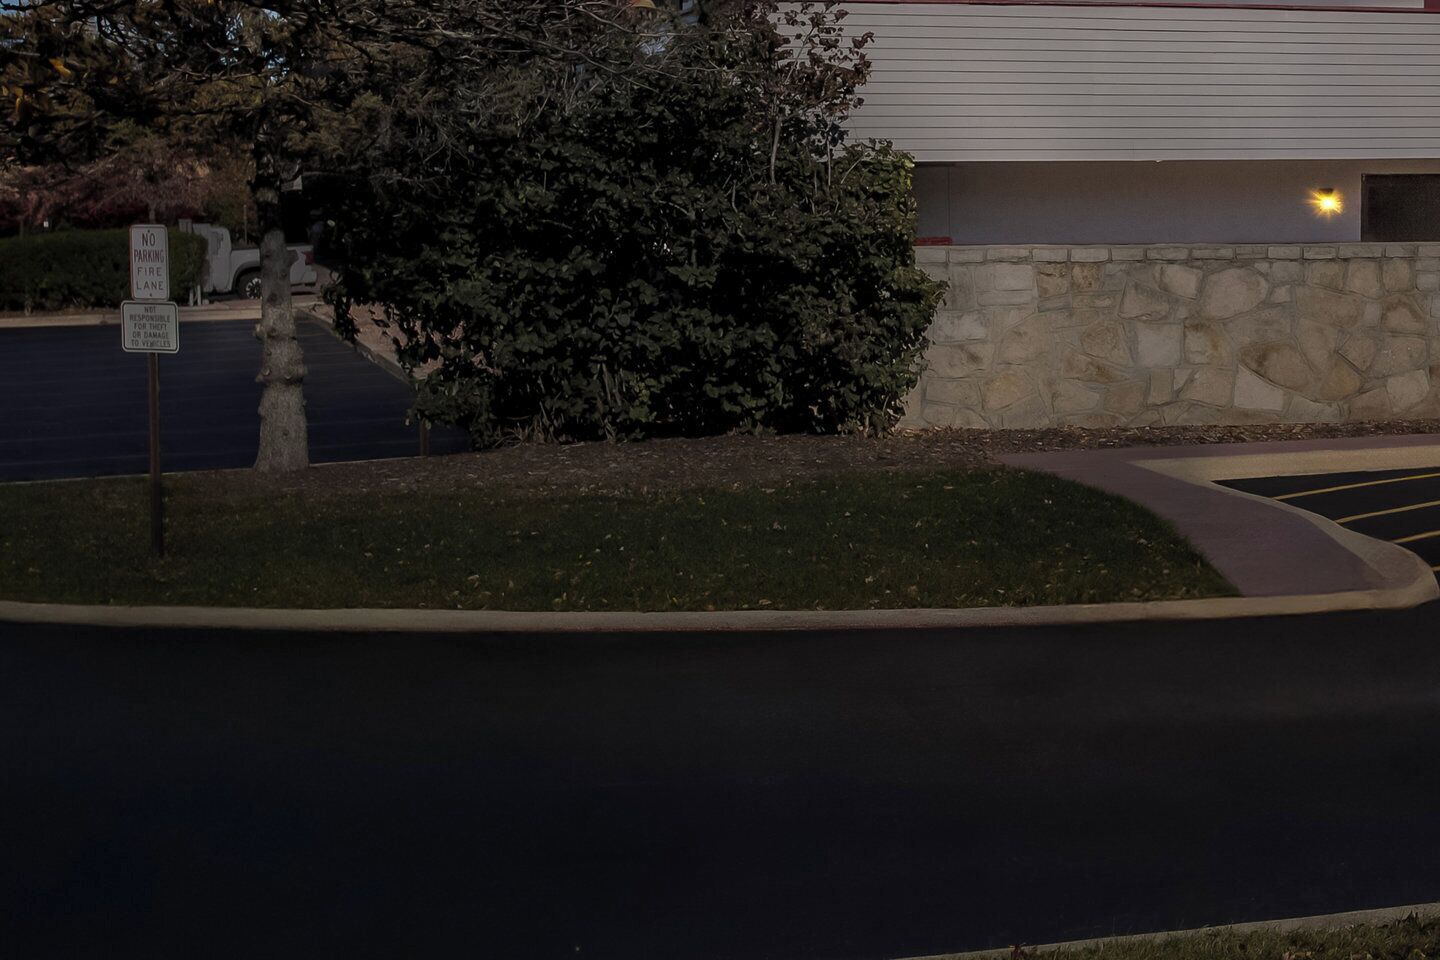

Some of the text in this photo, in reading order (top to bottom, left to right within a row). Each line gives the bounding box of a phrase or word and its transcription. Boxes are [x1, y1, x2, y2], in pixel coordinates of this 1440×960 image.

[141, 233, 156, 247] NO
[133, 250, 165, 263] PARKING
[137, 267, 162, 277] FIRE
[136, 281, 164, 291] LANE
[129, 314, 171, 323] RESPONSIBLE
[149, 323, 167, 331] THEFT
[132, 331, 169, 339] OR DAMAGE
[131, 339, 171, 348] TO VEHICLES
